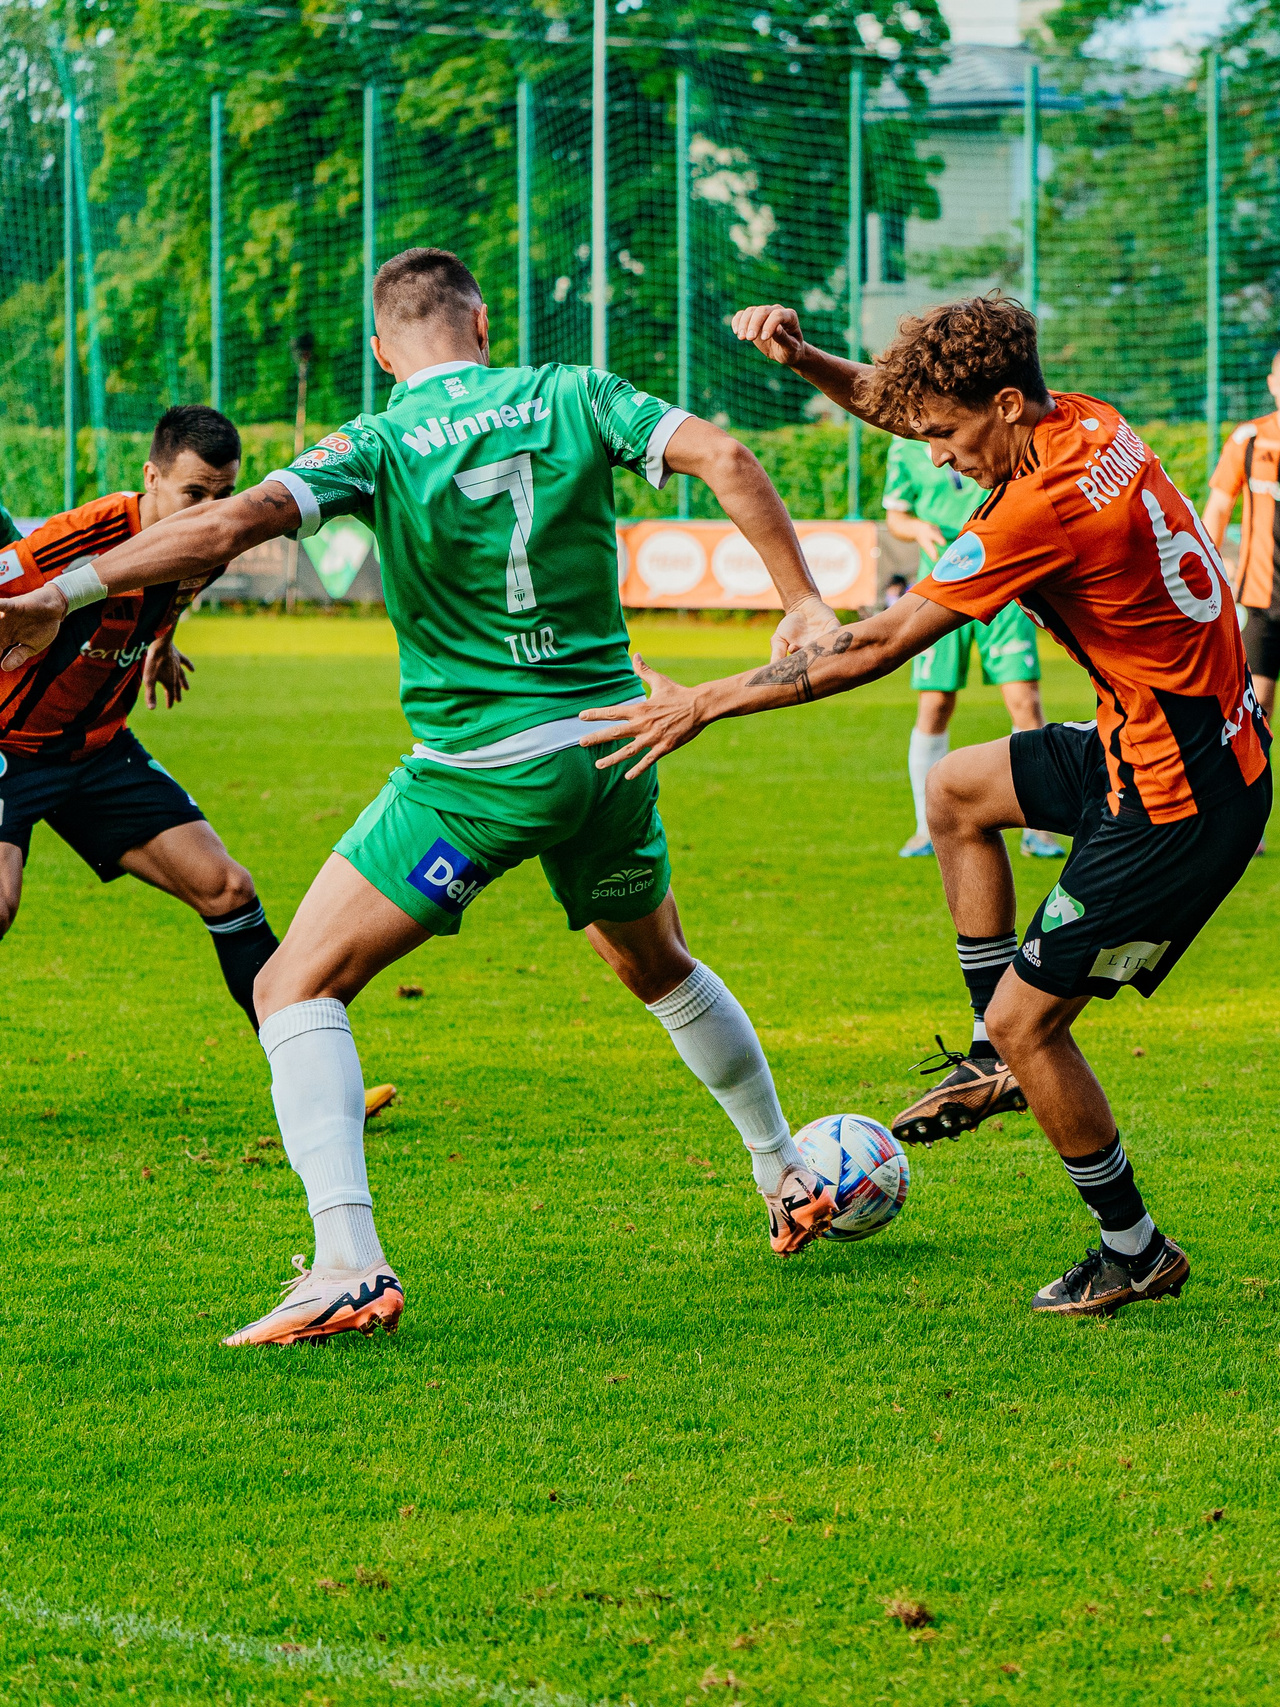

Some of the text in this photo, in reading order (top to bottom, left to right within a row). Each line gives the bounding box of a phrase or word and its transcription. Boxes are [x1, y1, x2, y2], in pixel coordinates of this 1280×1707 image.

[401, 397, 551, 457] Winnerz
[452, 452, 537, 614] 7
[504, 626, 558, 664] TUR
[591, 887, 626, 900] Saku
